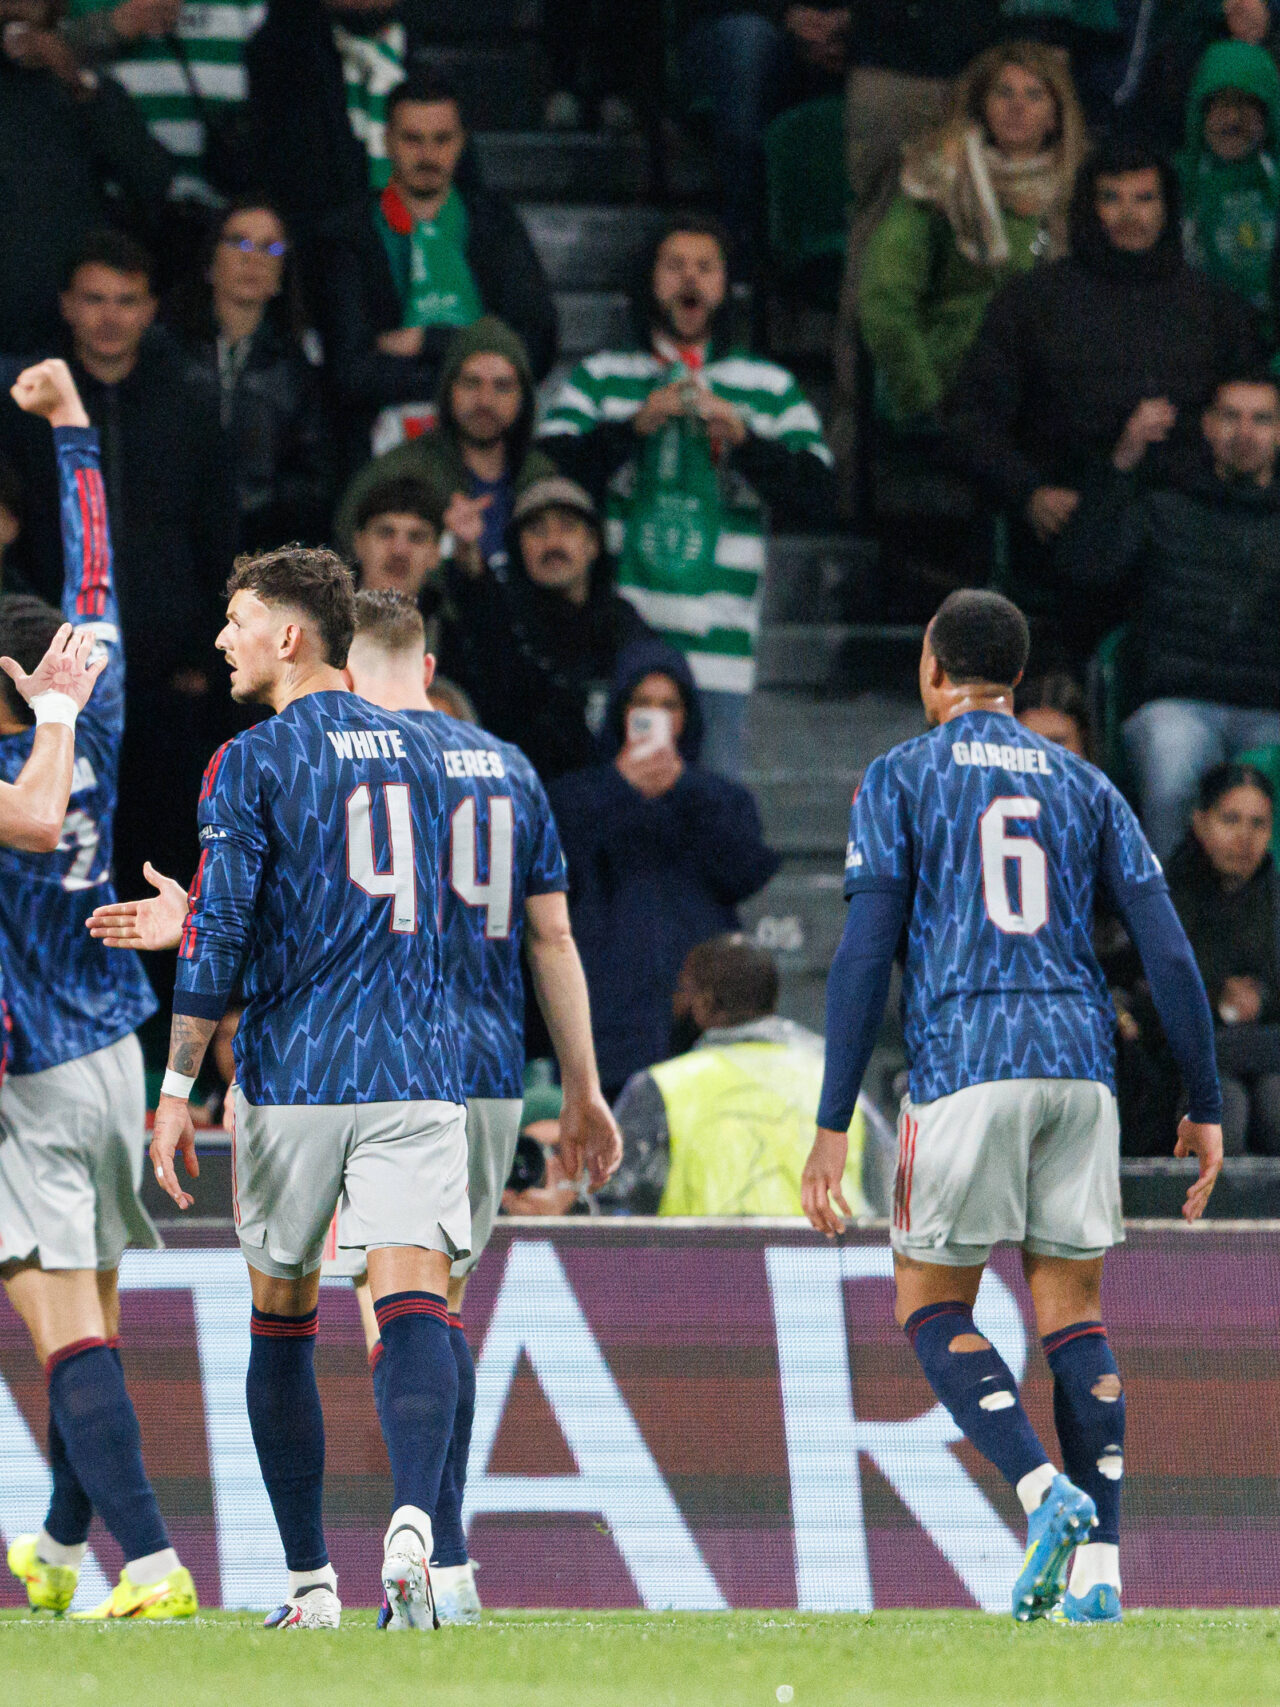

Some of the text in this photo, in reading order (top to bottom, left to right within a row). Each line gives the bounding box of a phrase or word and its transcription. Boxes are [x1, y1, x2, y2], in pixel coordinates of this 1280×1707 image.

[326, 730, 407, 759] WHITE
[952, 741, 1053, 775] GABRIEL
[345, 782, 418, 934] 4
[448, 795, 515, 940] 4
[978, 795, 1049, 936] 6
